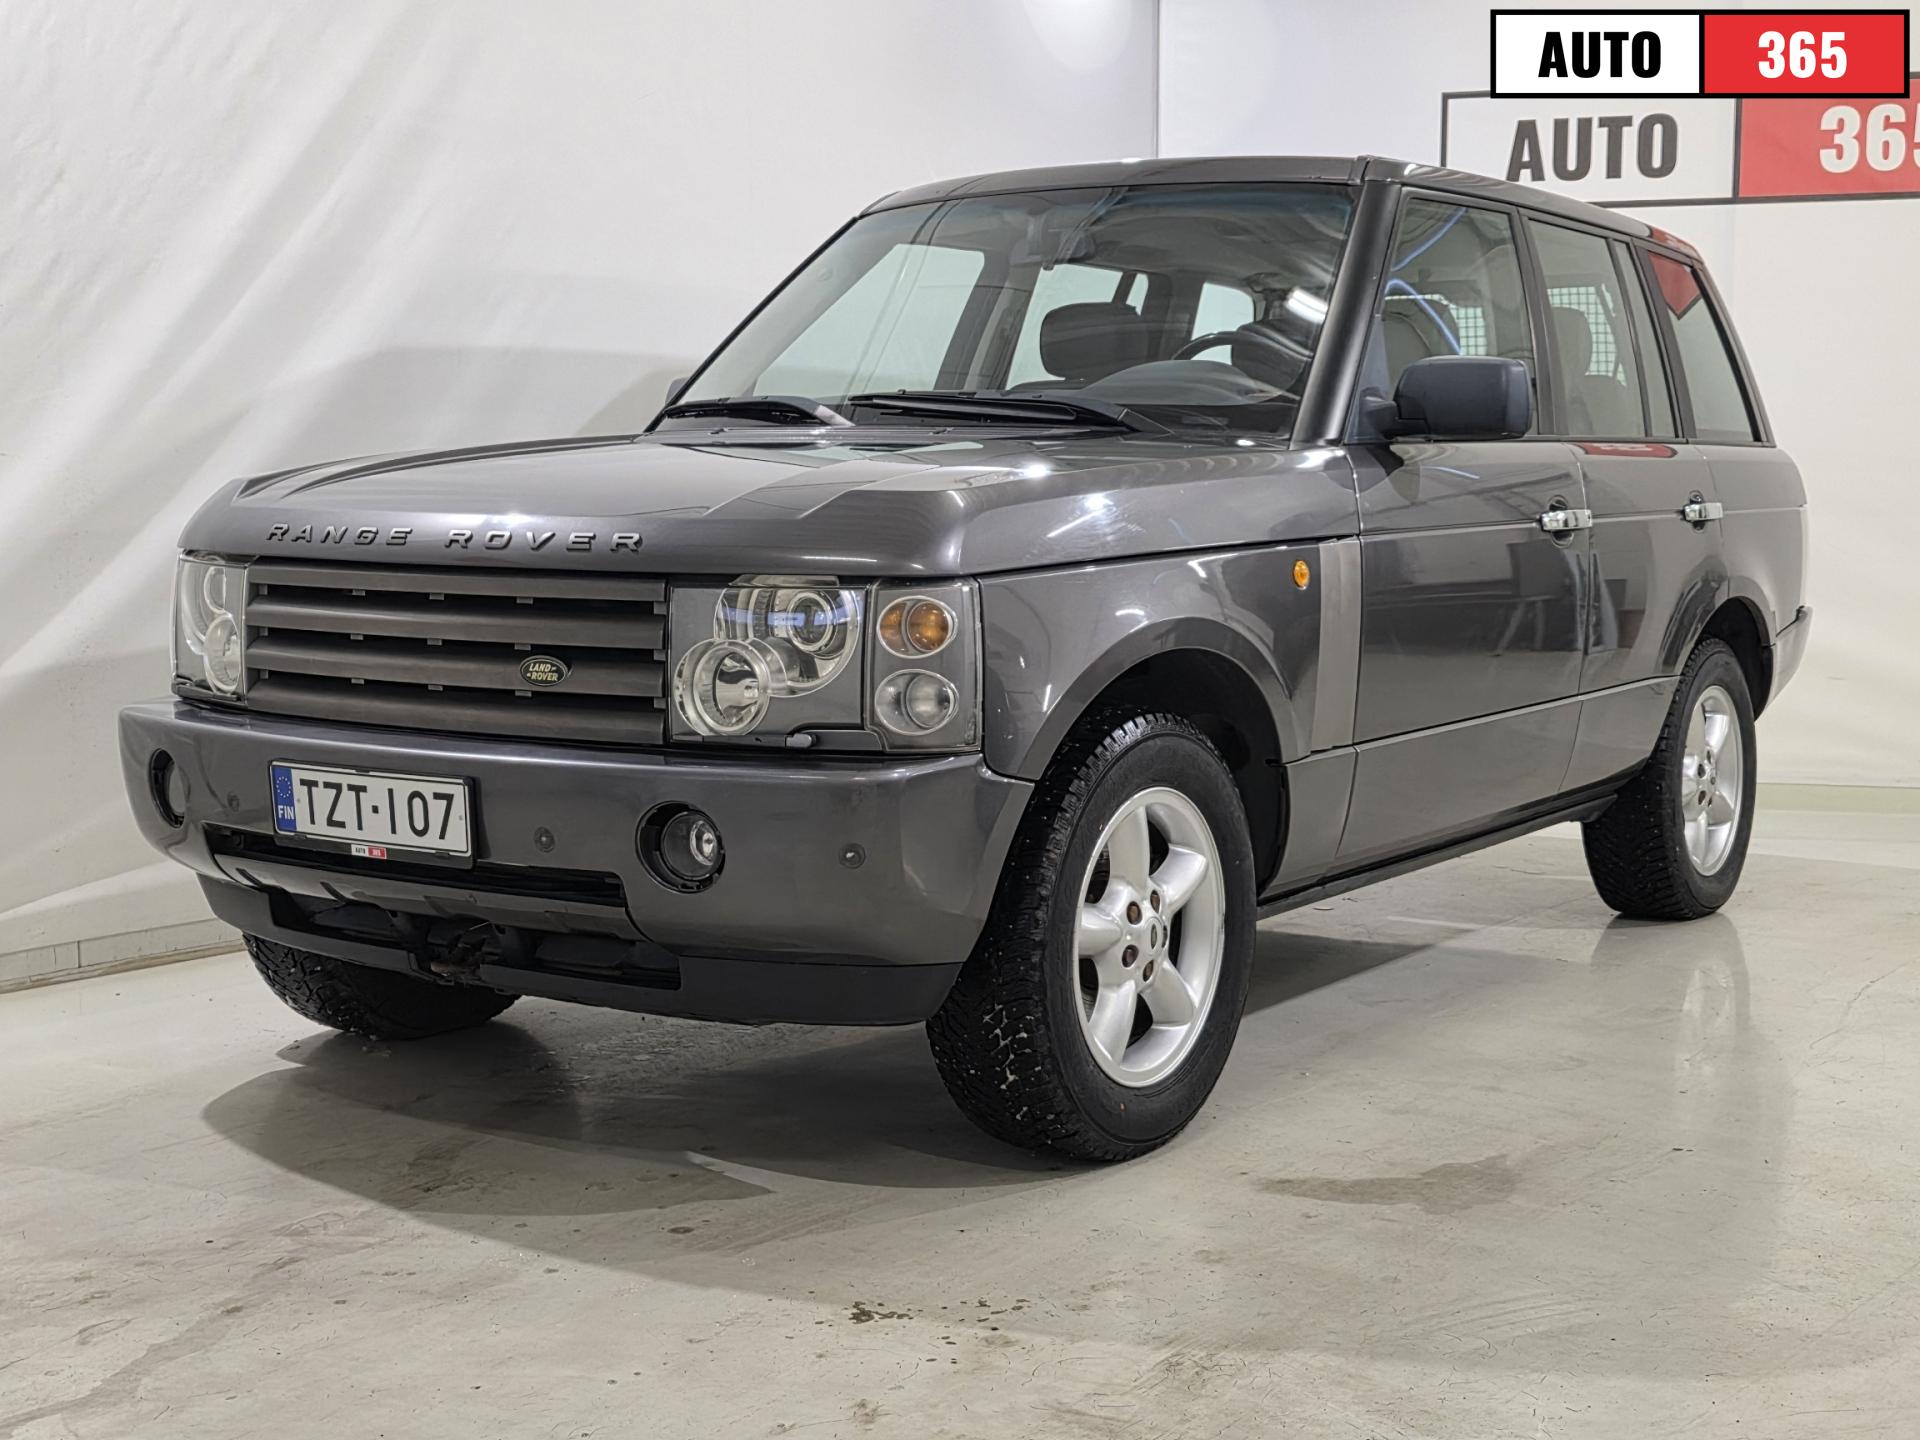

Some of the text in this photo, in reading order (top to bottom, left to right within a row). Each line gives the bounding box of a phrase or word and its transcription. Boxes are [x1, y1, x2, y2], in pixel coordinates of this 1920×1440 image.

[1506, 103, 1920, 182] AUTO 36
[266, 523, 643, 553] RANGE ROVER
[529, 663, 551, 672] LAND
[531, 672, 558, 681] ROVER
[278, 805, 295, 820] FIN
[299, 778, 454, 840] TZT-107
